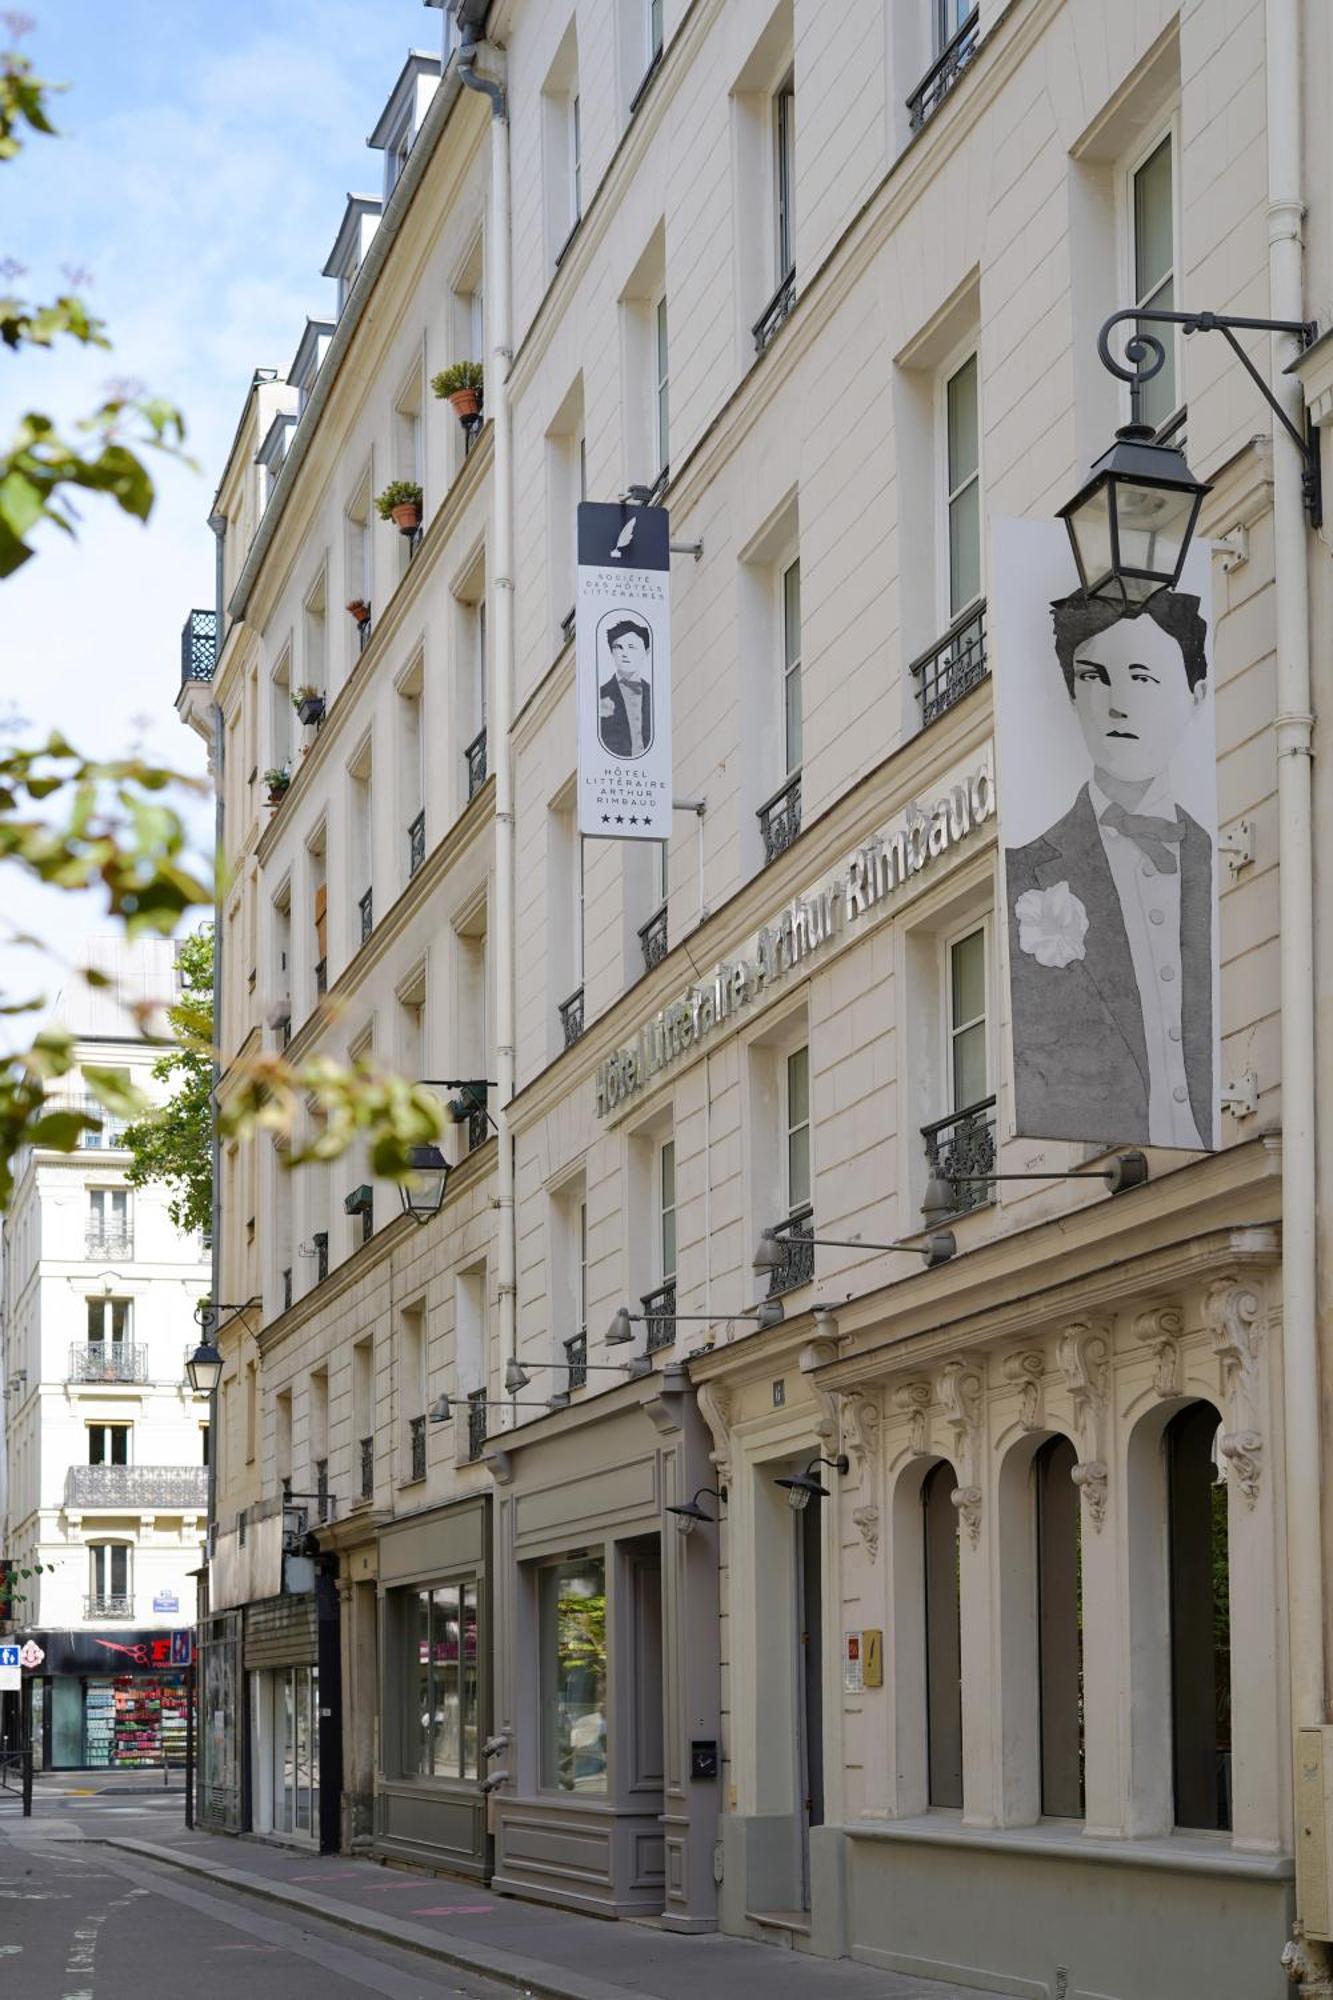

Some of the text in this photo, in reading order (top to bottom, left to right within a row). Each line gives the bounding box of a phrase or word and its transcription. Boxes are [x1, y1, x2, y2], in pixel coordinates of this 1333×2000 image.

[604, 766, 648, 778] HÔTEL
[586, 776, 666, 789] LITTÉRAIRE
[600, 788, 653, 797] ARTHUR
[597, 797, 657, 807] RIMBAUD
